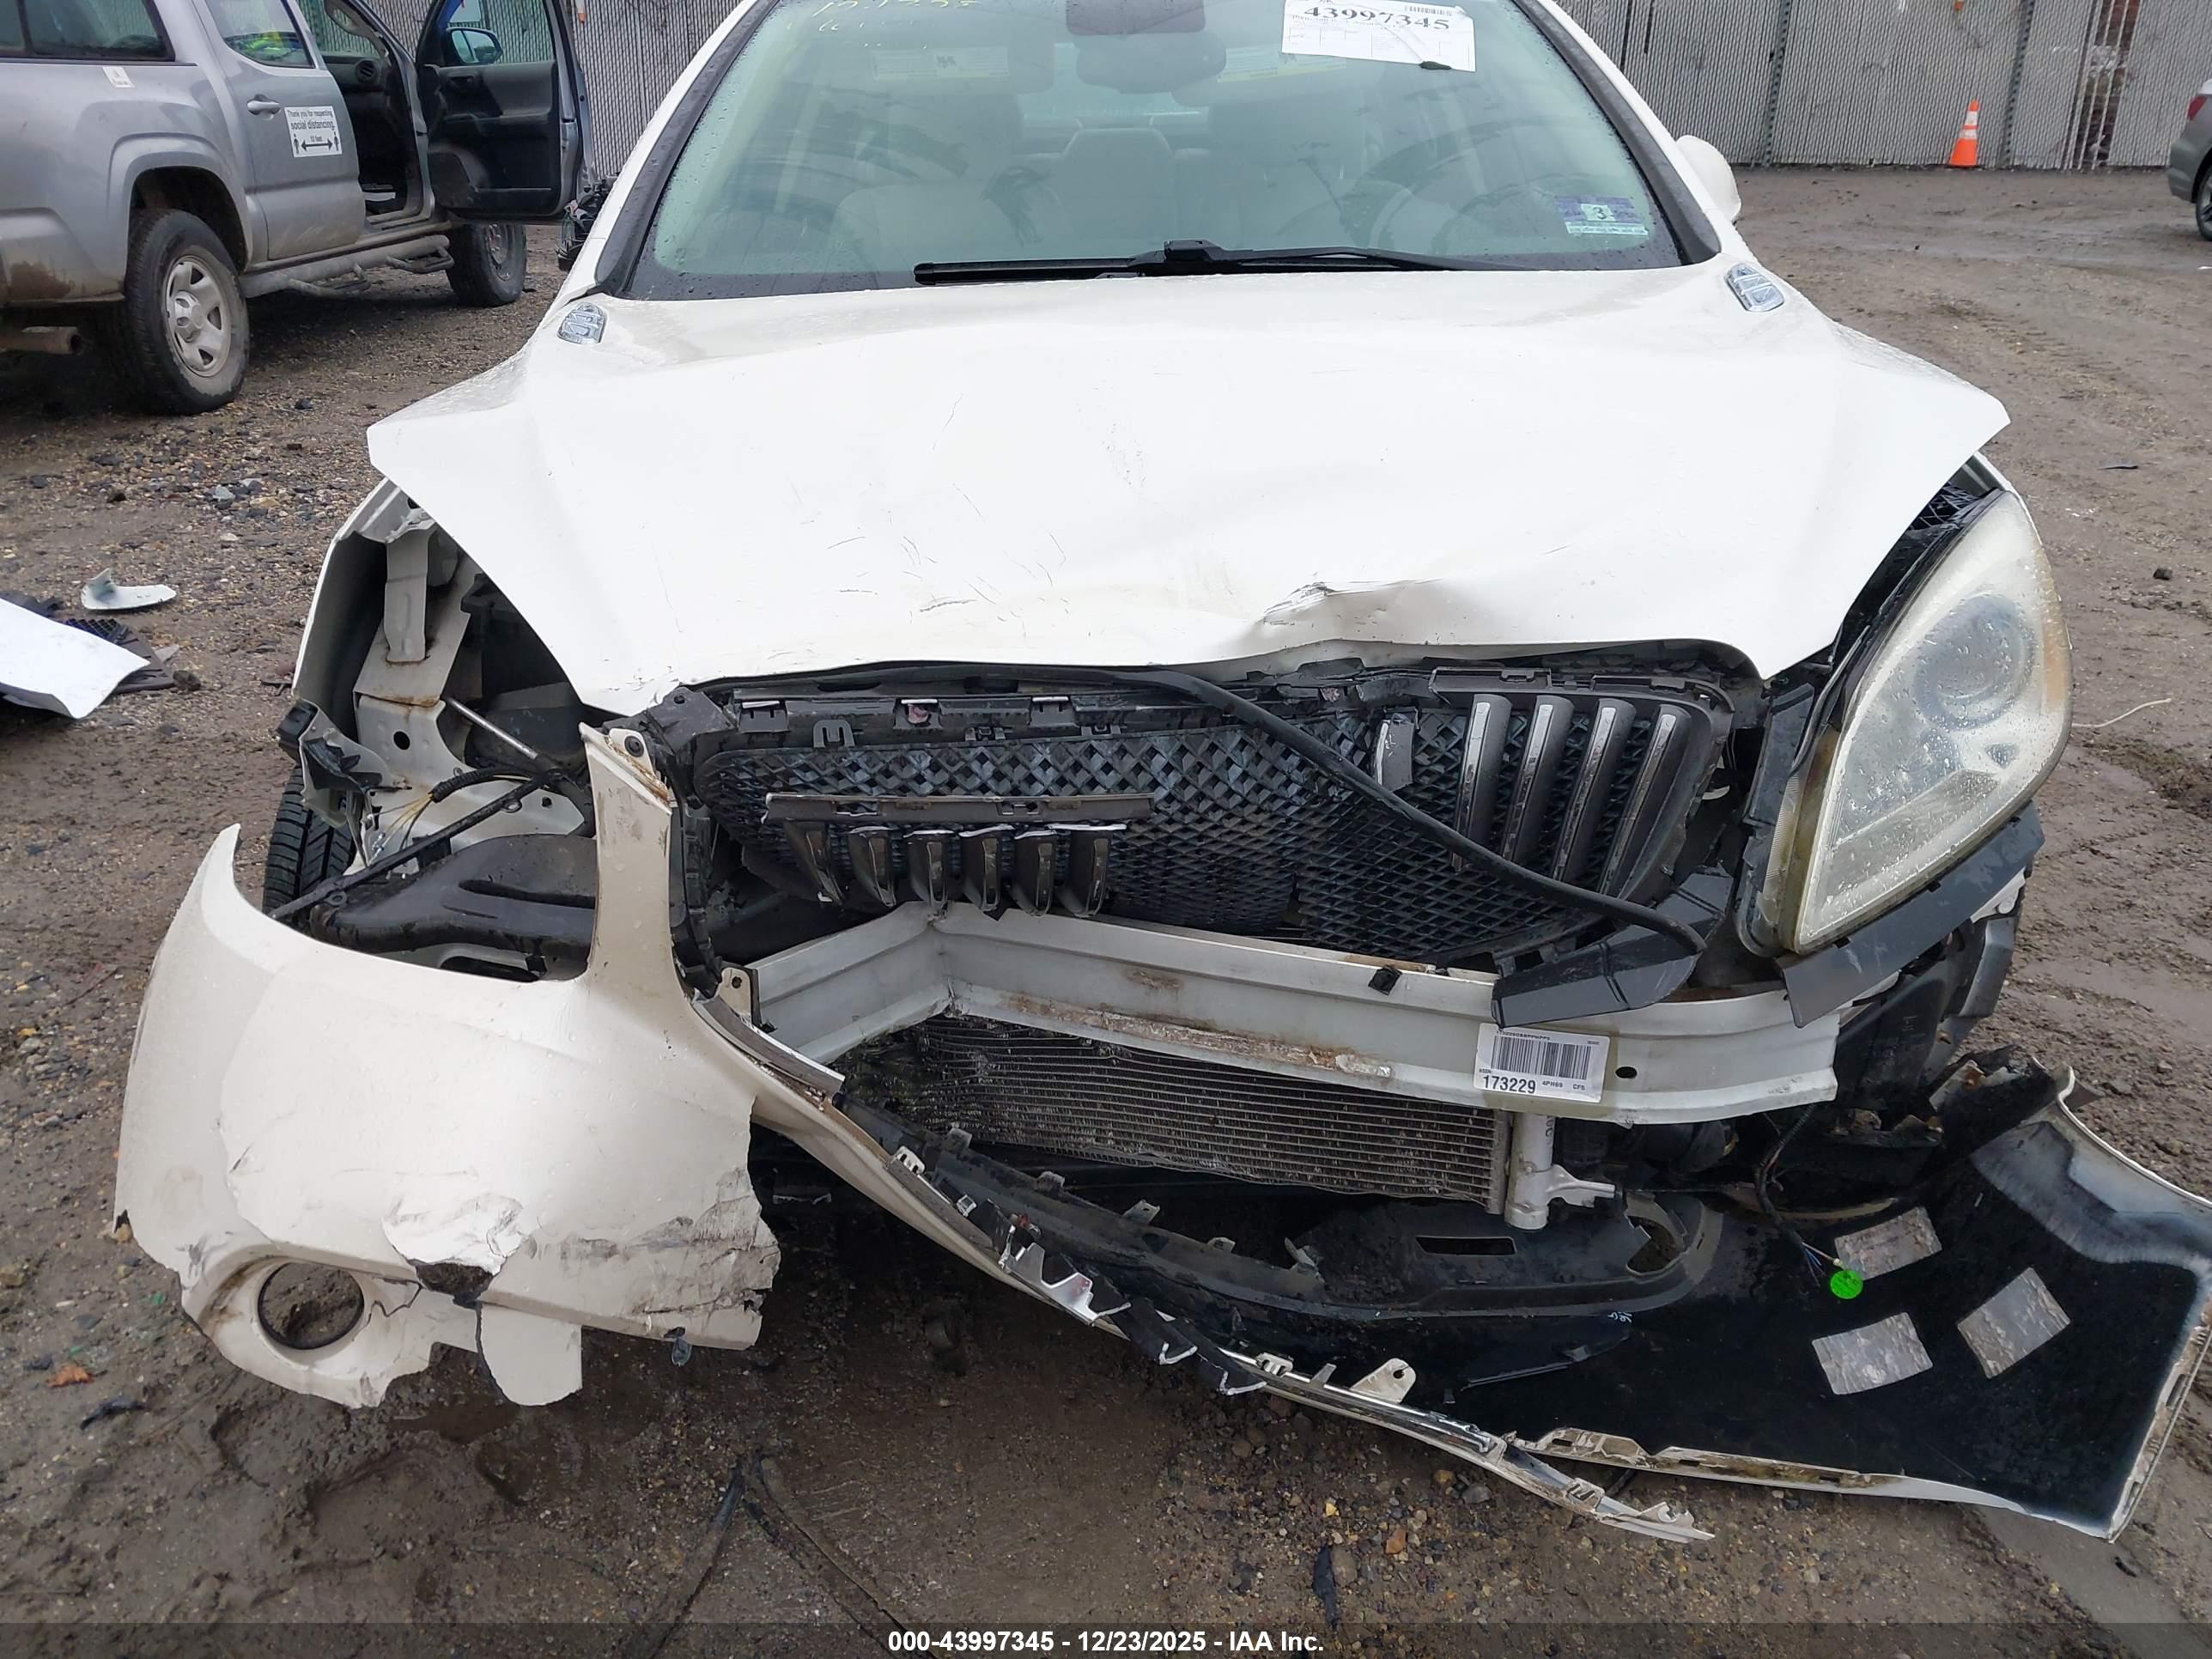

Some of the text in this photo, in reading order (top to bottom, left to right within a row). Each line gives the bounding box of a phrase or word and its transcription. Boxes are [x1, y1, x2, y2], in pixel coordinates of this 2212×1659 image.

[1304, 6, 1449, 30] 43997345
[290, 119, 307, 131] social
[1593, 206, 1607, 220] 3
[1483, 1075, 1536, 1094] 173229
